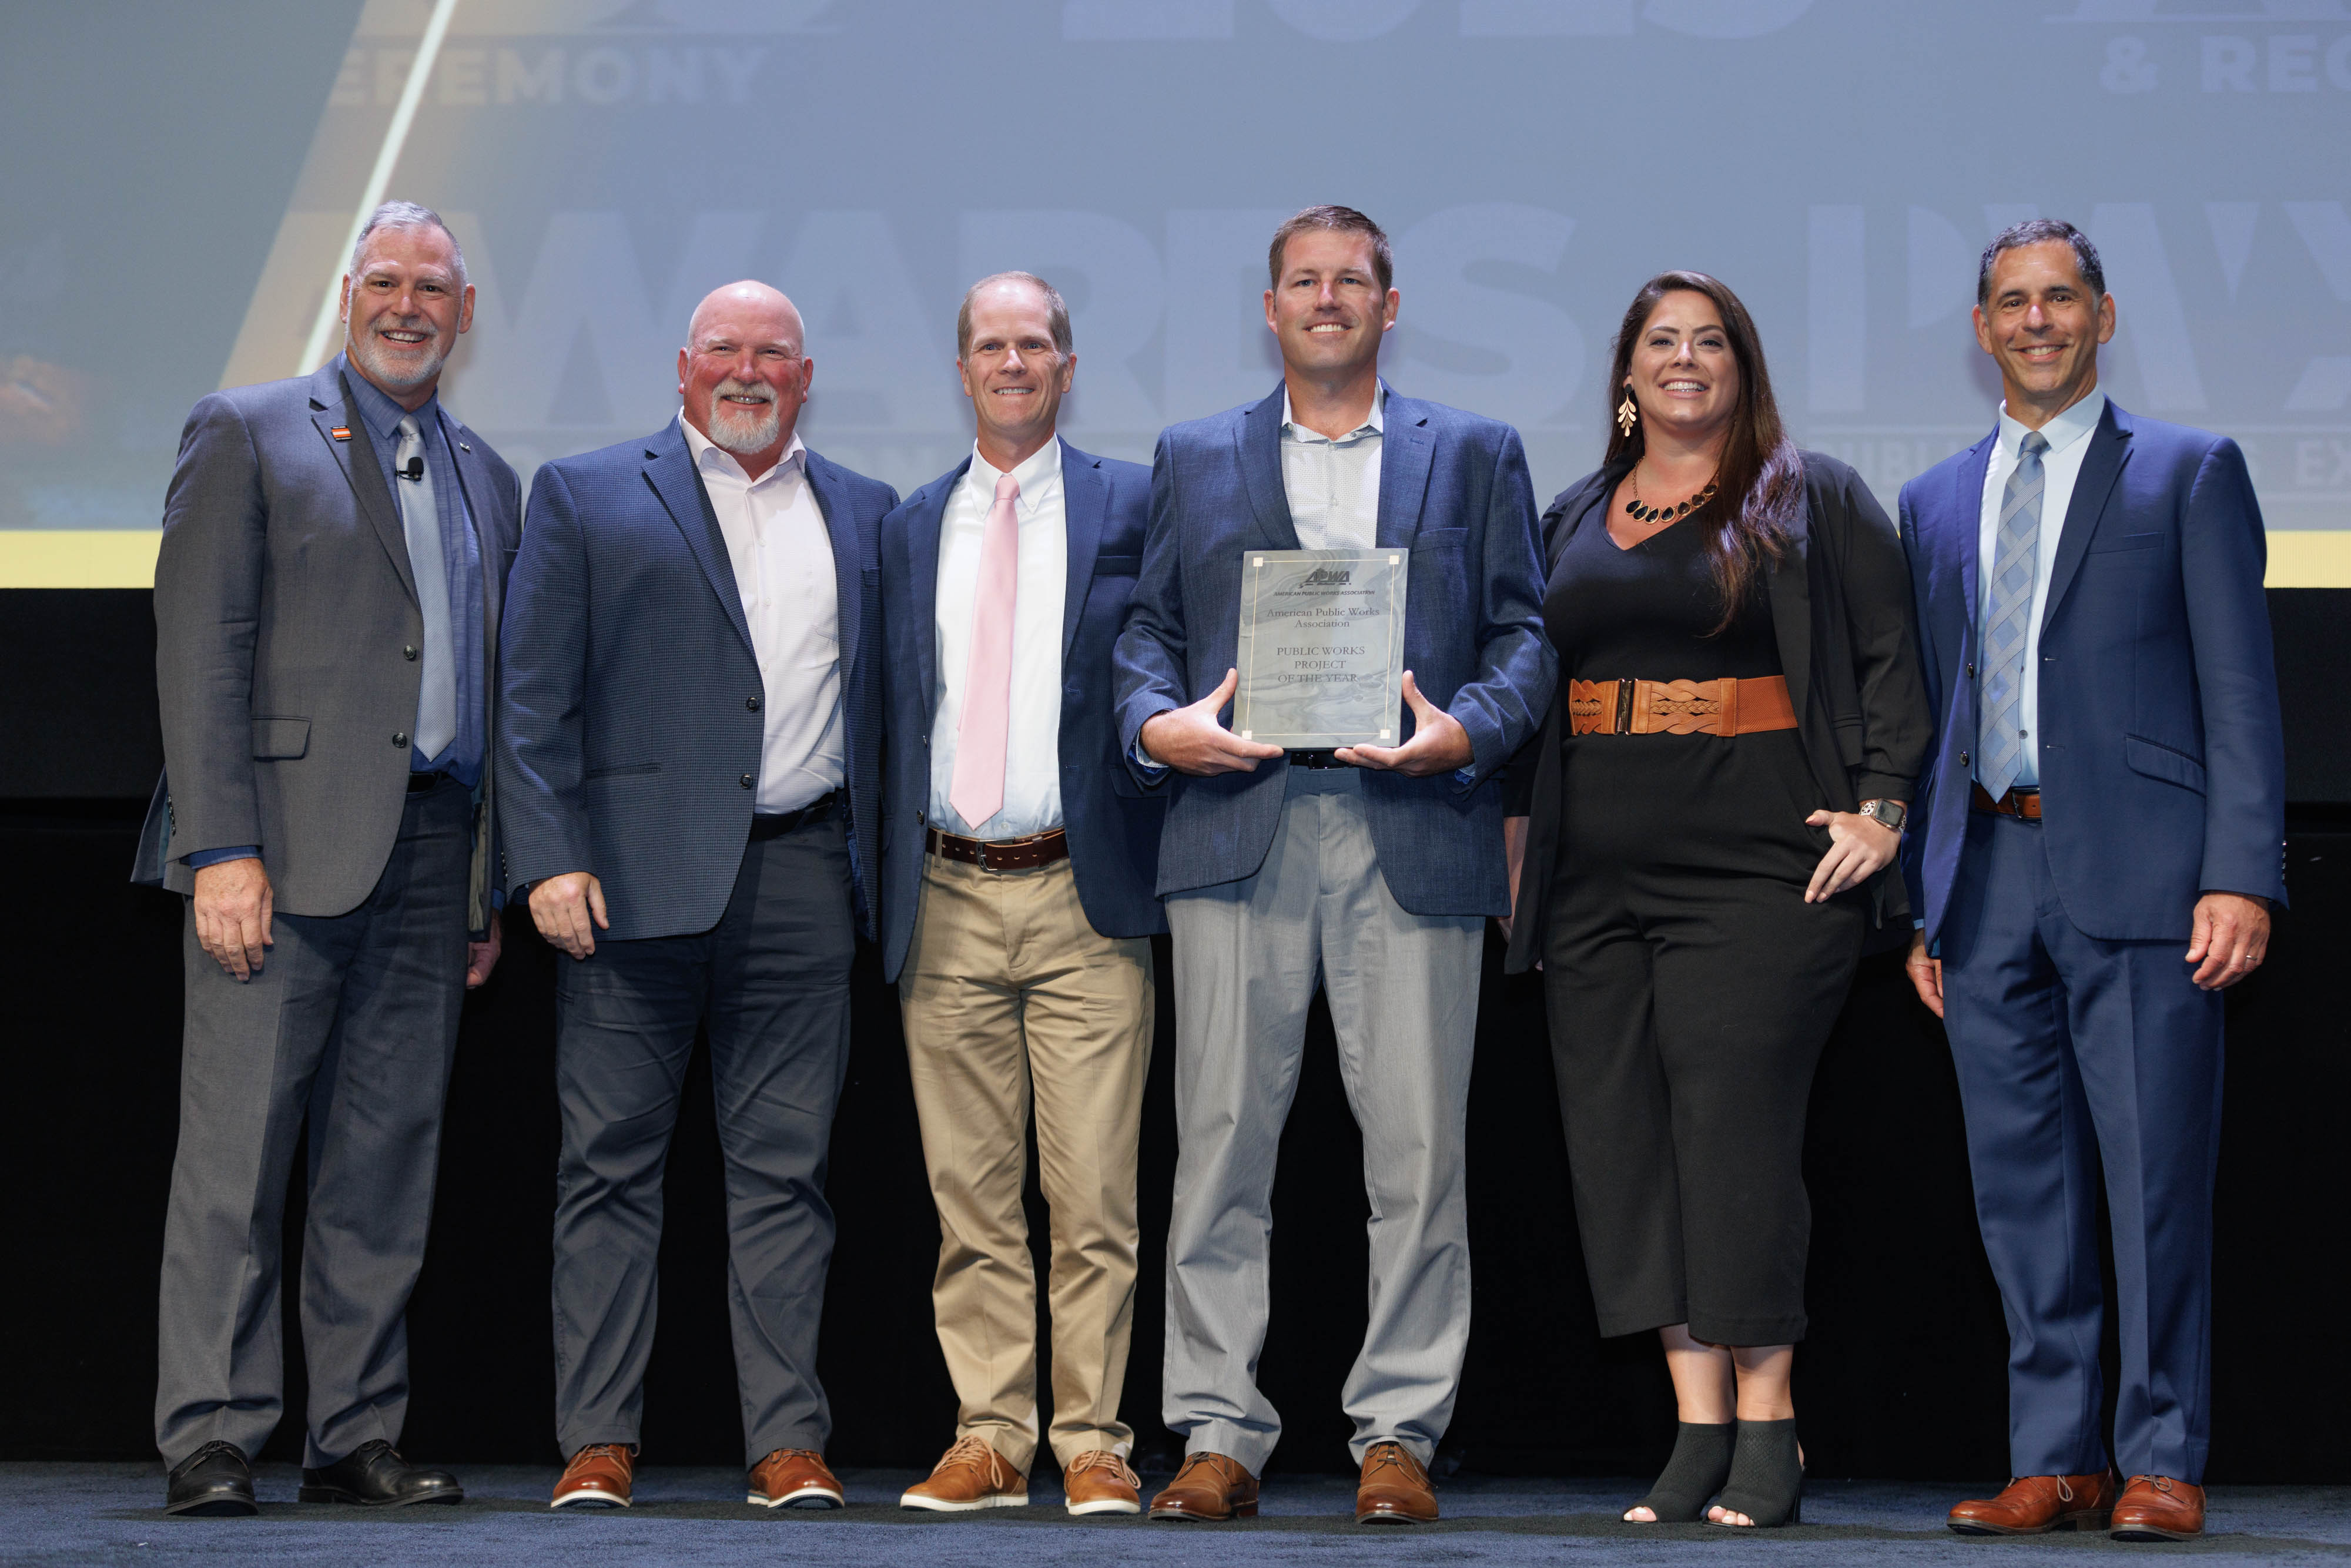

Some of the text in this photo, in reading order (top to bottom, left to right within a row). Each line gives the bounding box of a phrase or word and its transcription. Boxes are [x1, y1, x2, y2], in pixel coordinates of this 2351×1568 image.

[2098, 35, 2159, 94] &
[1303, 568, 1350, 583] APWA
[1267, 607, 1379, 617] American Public Works
[1295, 619, 1350, 628] Association
[1277, 646, 1365, 656] PUBLIC WORKS
[1294, 660, 1346, 671] PROJECT
[1278, 674, 1358, 683] OF THE YEAR
